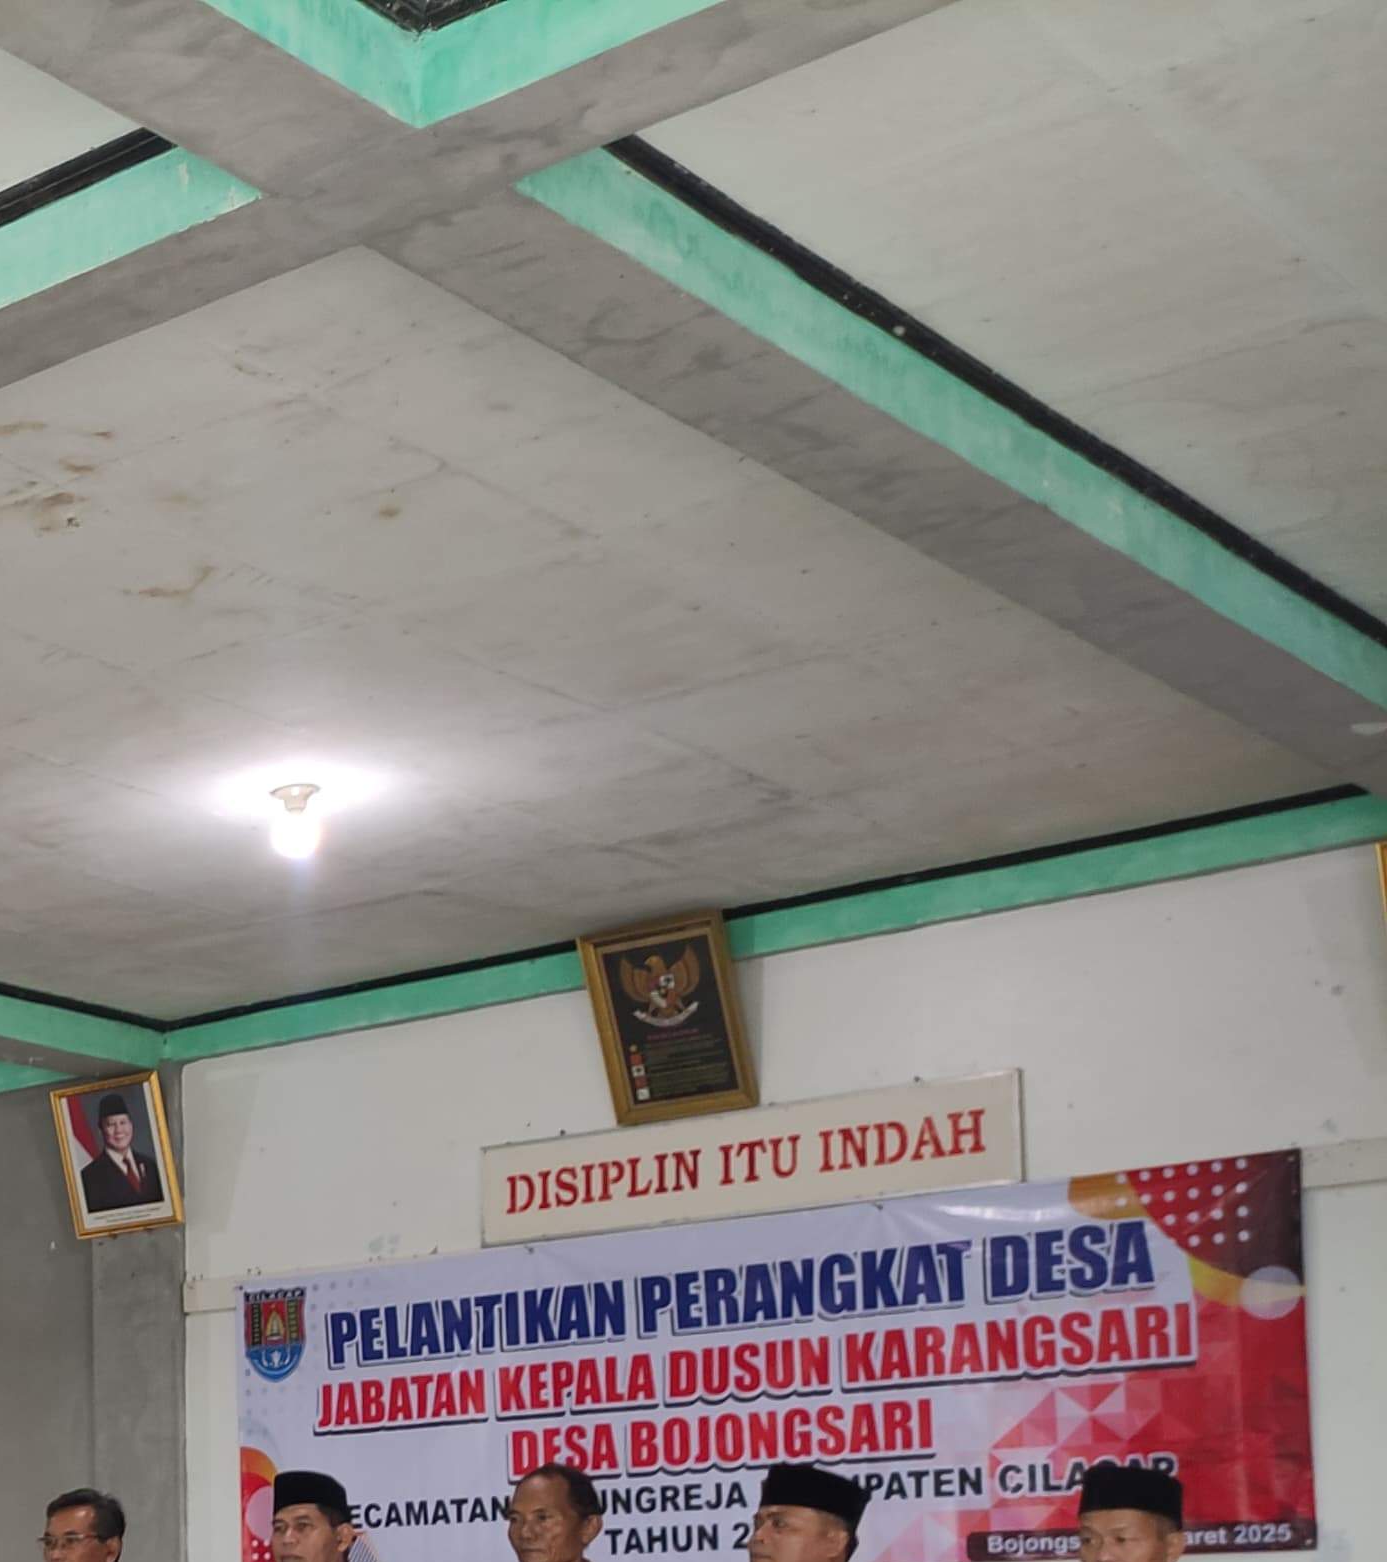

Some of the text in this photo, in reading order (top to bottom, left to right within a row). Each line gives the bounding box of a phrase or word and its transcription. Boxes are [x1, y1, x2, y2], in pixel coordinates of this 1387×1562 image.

[505, 1108, 987, 1215] DISIPLIN ITU INDAH
[328, 1219, 1156, 1366] PELANTIKAN PERANGKAT DESA
[317, 1302, 1194, 1429] JABATAN KEPALA DUSUN KARANGSARI
[510, 1397, 934, 1478] DESA BOJONGSARI
[348, 1496, 511, 1529] ECAMATAN
[853, 1467, 984, 1501] PATEN
[604, 1523, 720, 1555] TAHUN
[986, 1523, 1293, 1557] Bojongs aret 2025
